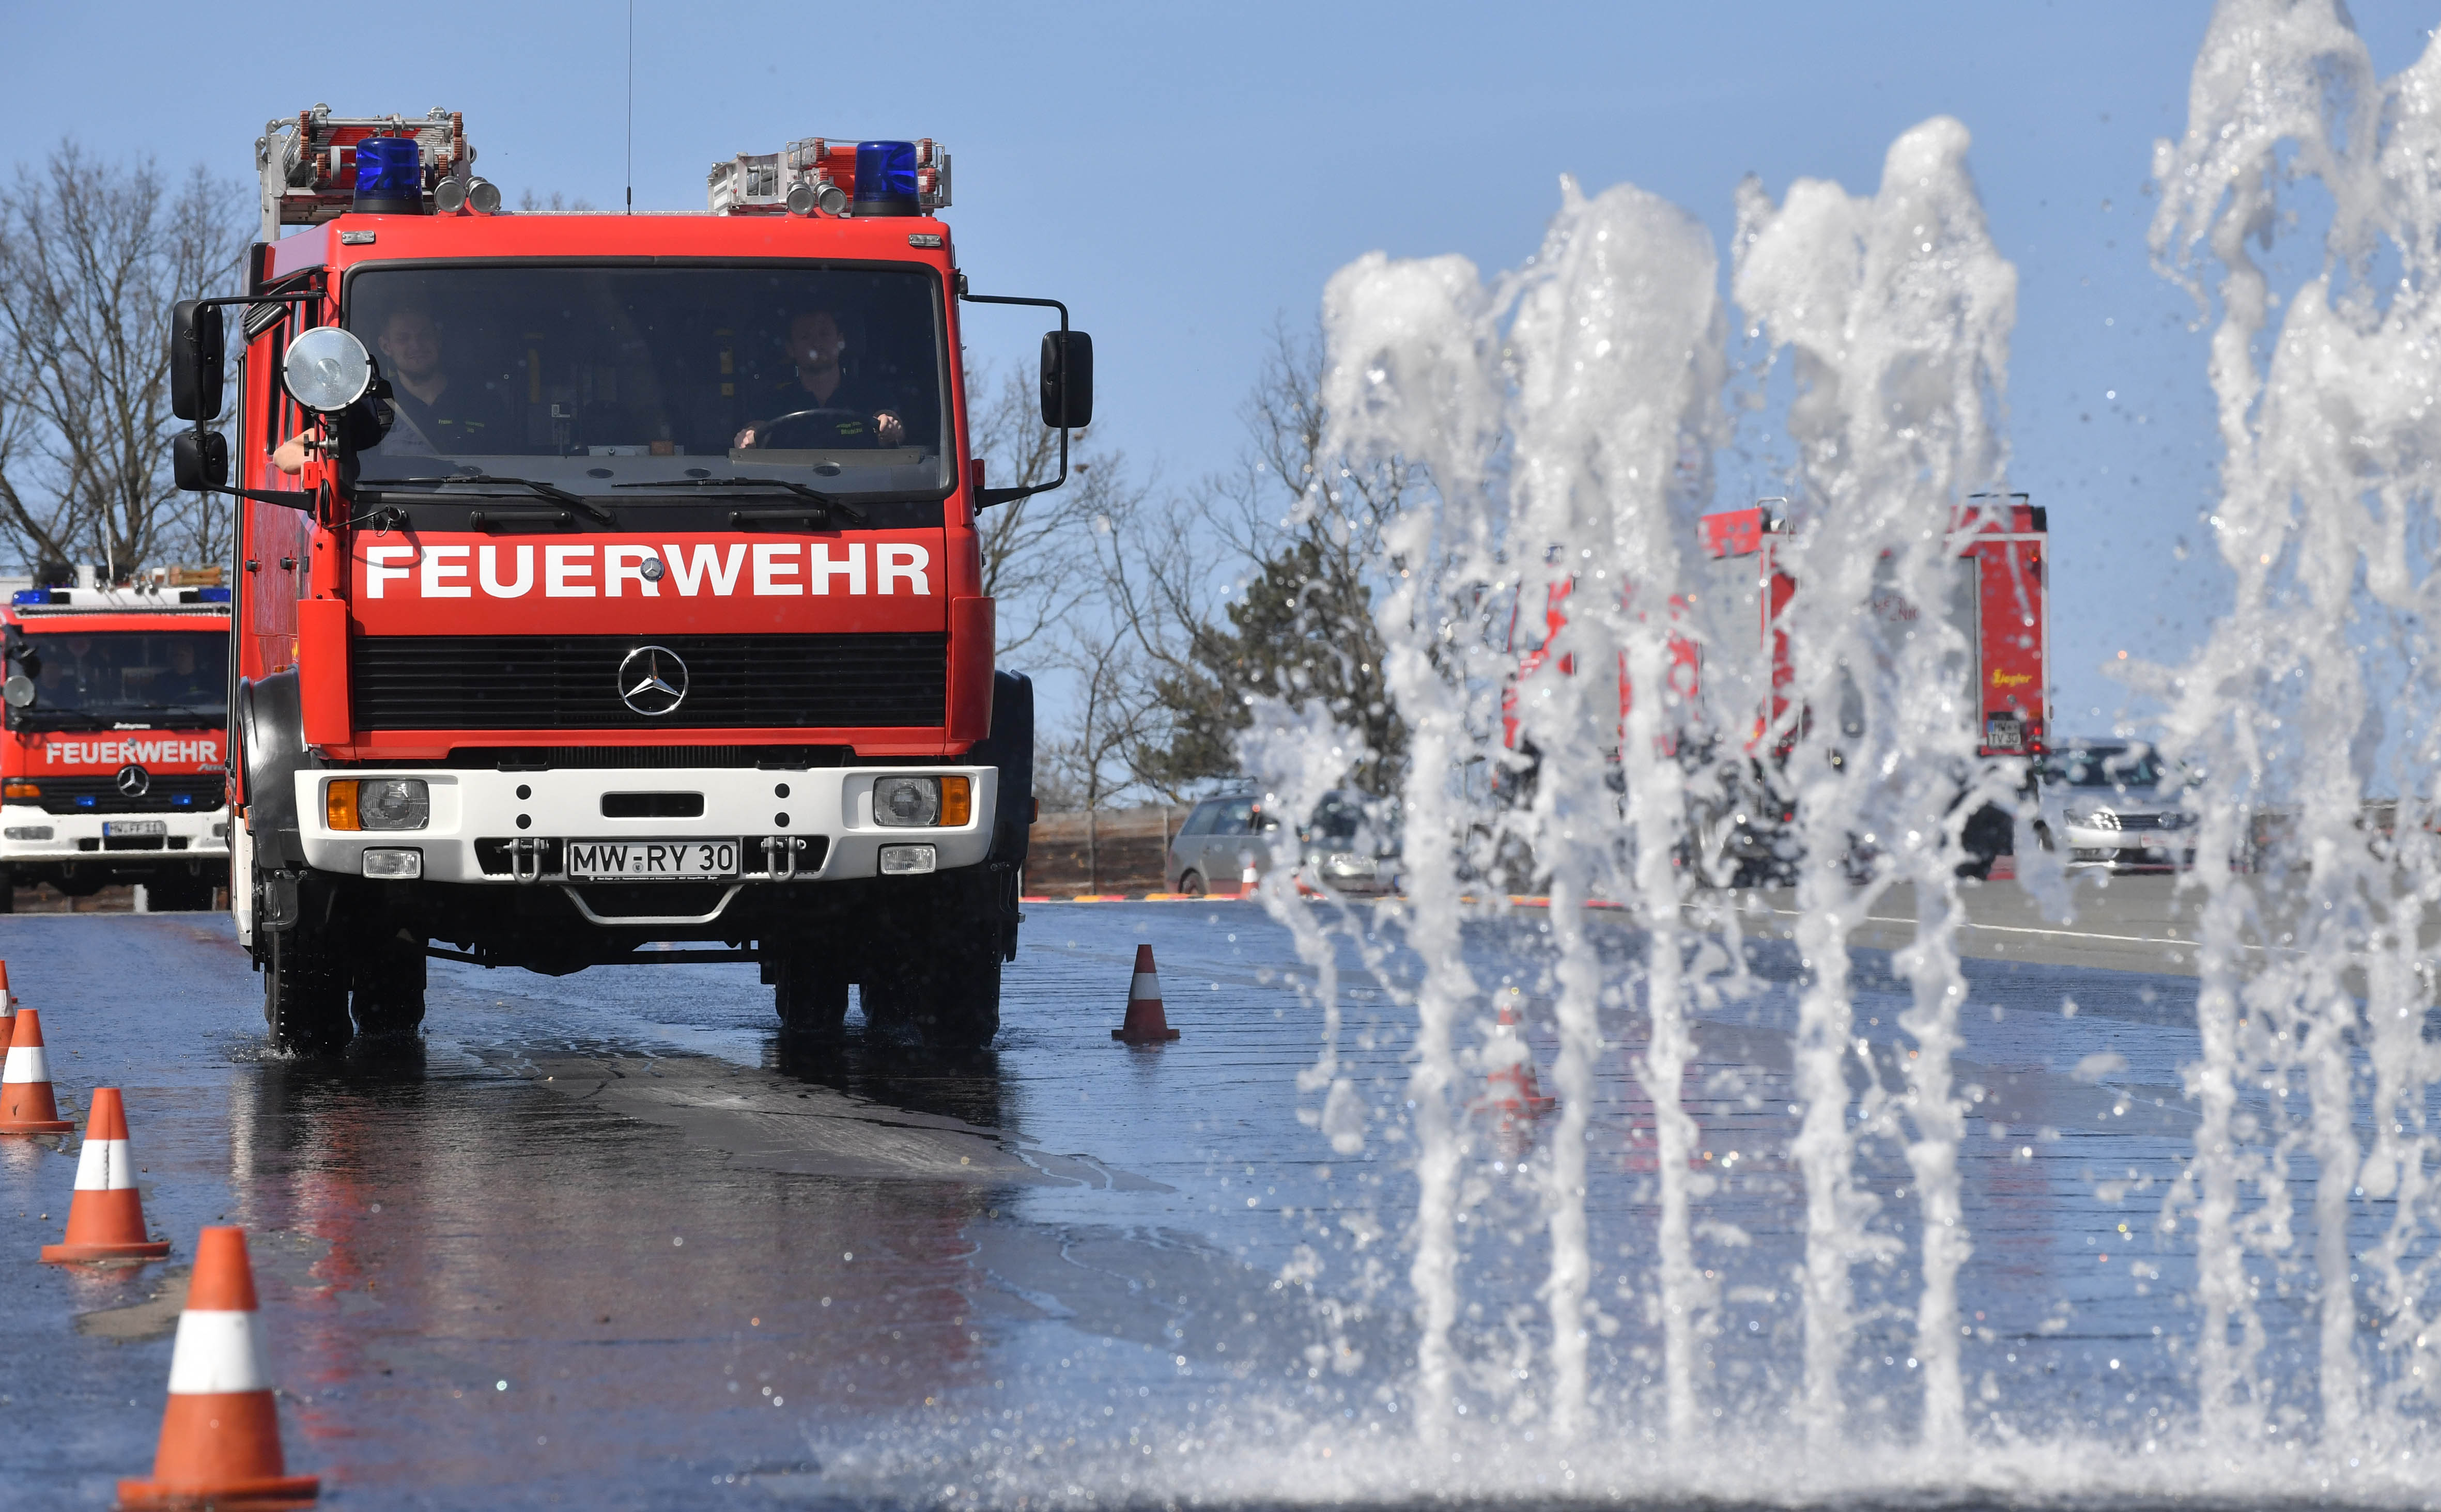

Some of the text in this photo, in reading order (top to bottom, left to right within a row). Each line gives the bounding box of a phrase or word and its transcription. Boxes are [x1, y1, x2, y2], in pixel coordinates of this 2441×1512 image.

[366, 543, 931, 599] FEUERWEHR
[47, 741, 218, 764] FEUERWEHR
[573, 845, 733, 871] MW-RY 30
